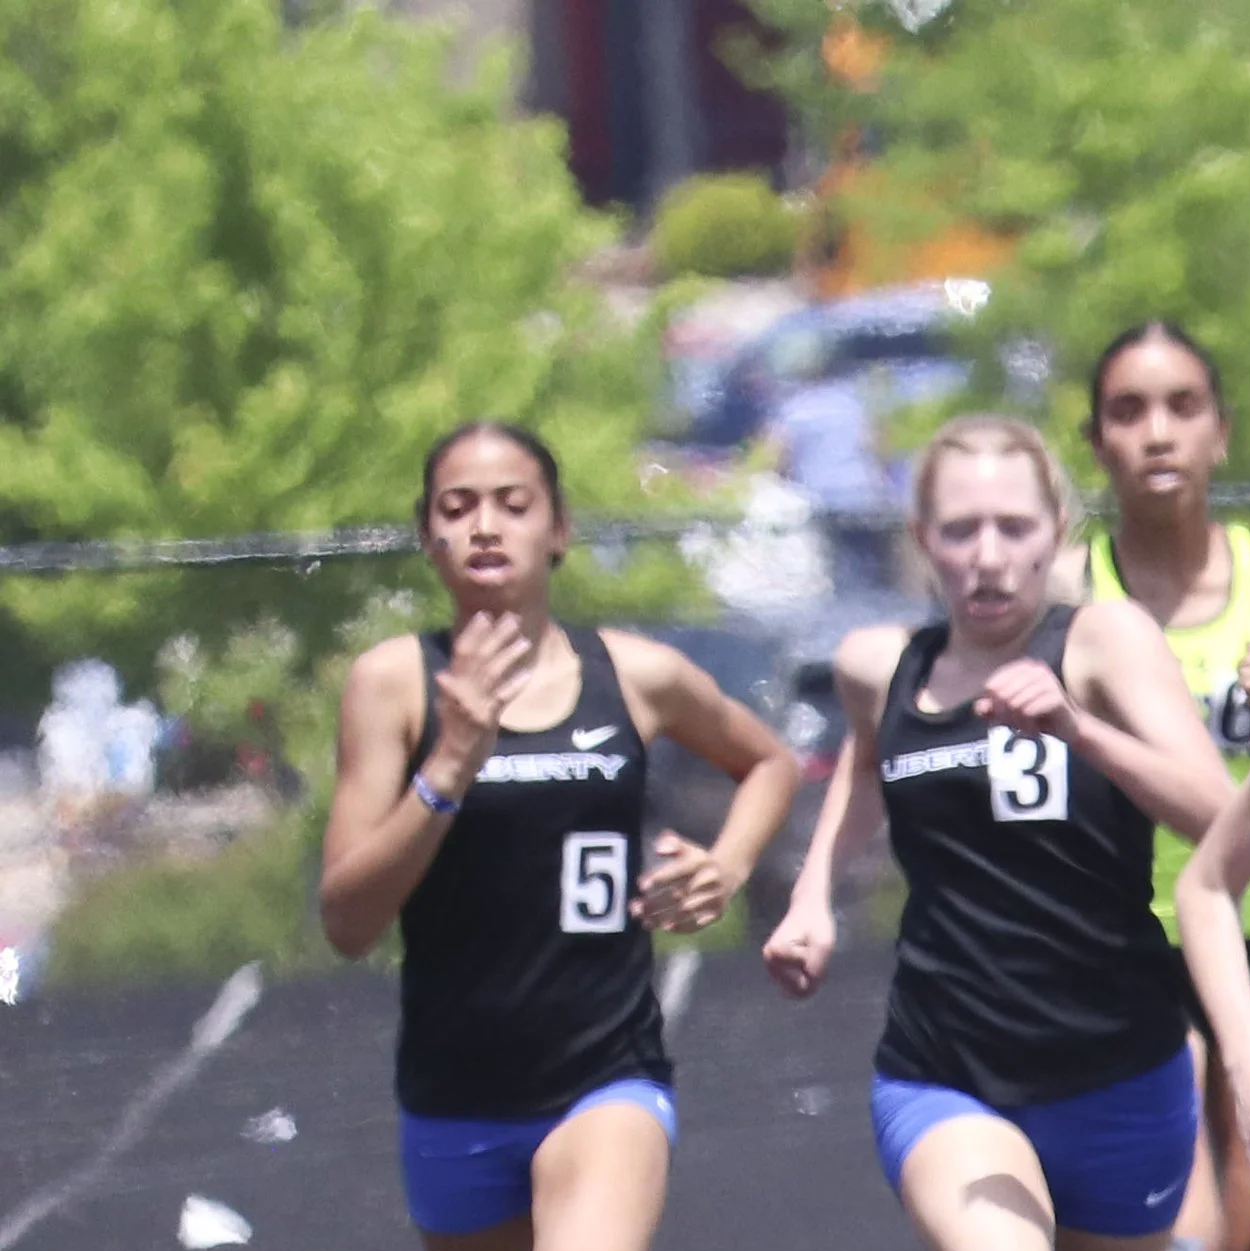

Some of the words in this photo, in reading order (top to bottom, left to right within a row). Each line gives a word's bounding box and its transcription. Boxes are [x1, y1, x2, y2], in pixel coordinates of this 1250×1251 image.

[475, 752, 628, 782] BERTY
[880, 739, 989, 782] LIBERT
[1003, 731, 1050, 815] 3
[575, 845, 615, 922] 5
